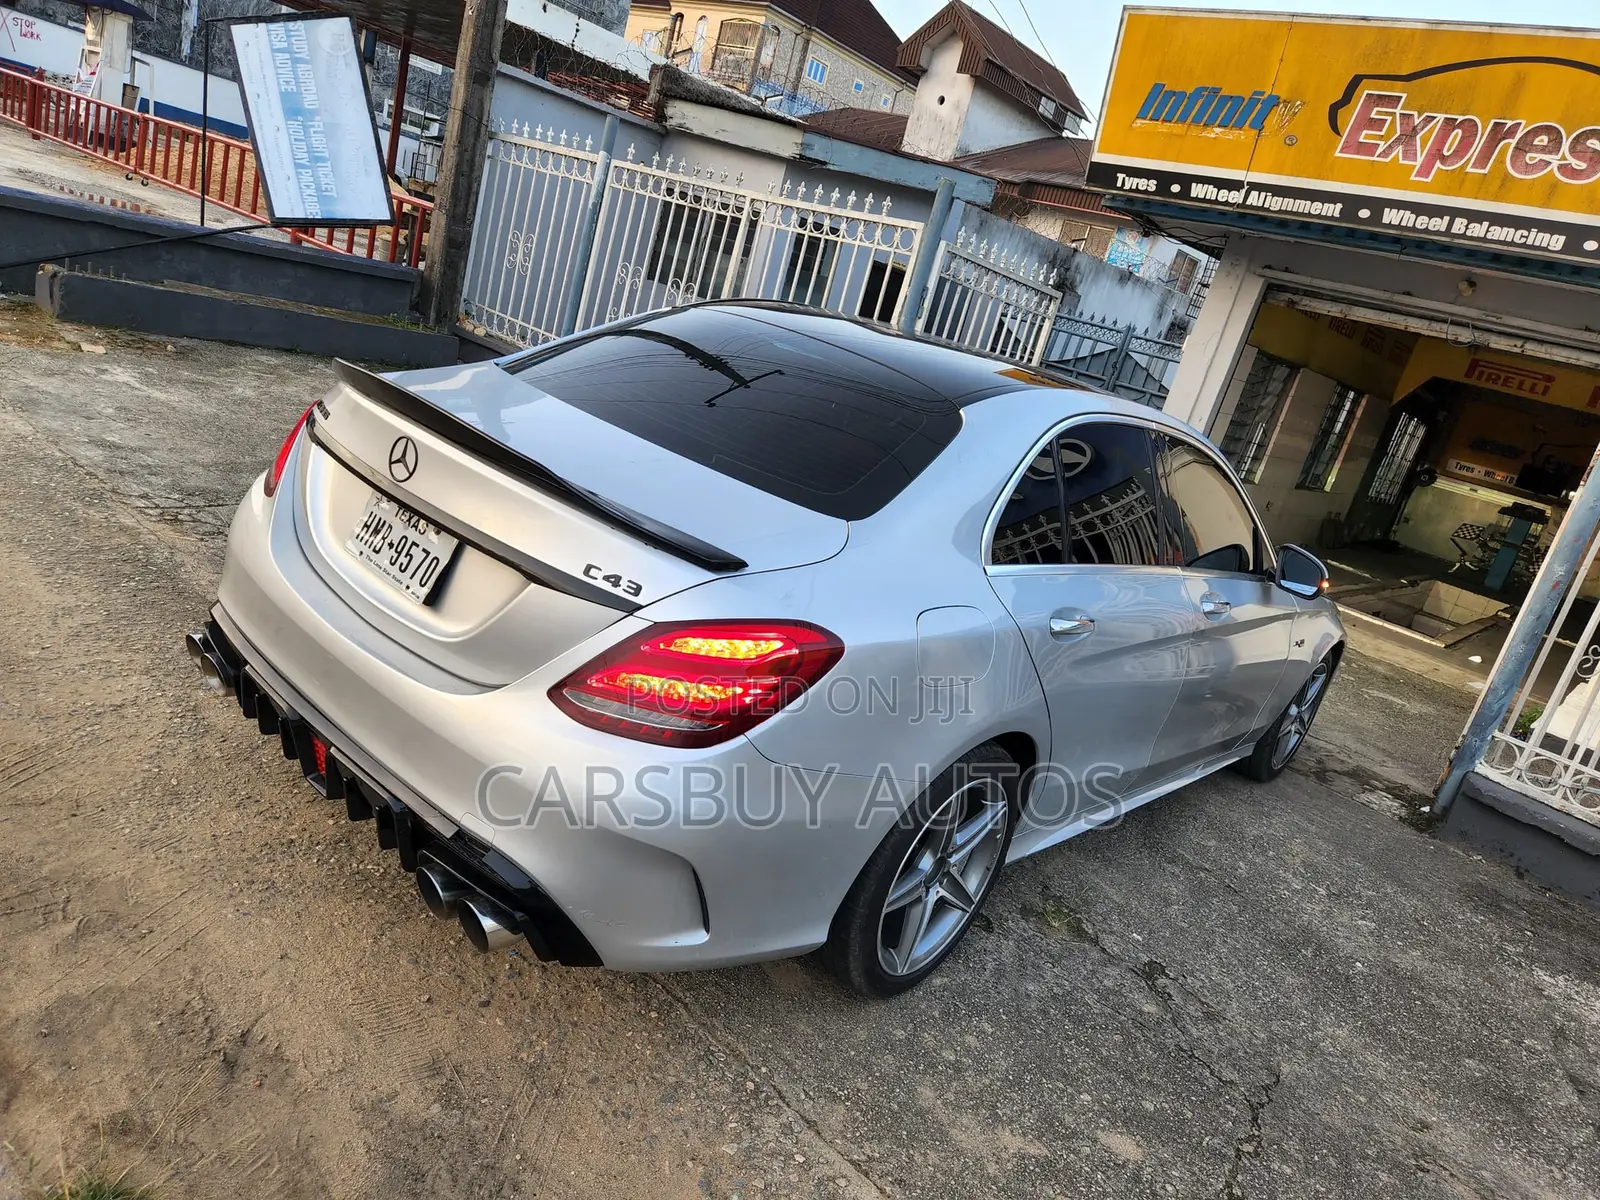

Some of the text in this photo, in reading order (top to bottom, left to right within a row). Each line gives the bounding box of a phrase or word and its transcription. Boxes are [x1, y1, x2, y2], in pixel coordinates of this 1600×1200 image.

[13, 17, 36, 29] STOP
[20, 30, 41, 41] WORK
[268, 22, 297, 93] VISA ADVICE
[288, 20, 318, 109] STUDY ABROAD
[308, 120, 337, 198] FLIGHT TICKET
[1116, 173, 1567, 250] Tyres Wheel Alignment Wheel Balancing
[1464, 358, 1556, 396] PIRELLI
[1454, 461, 1475, 474] Tyres
[394, 505, 429, 535] TEXAS
[365, 554, 404, 585] The Lone Star State
[583, 563, 642, 597] C43
